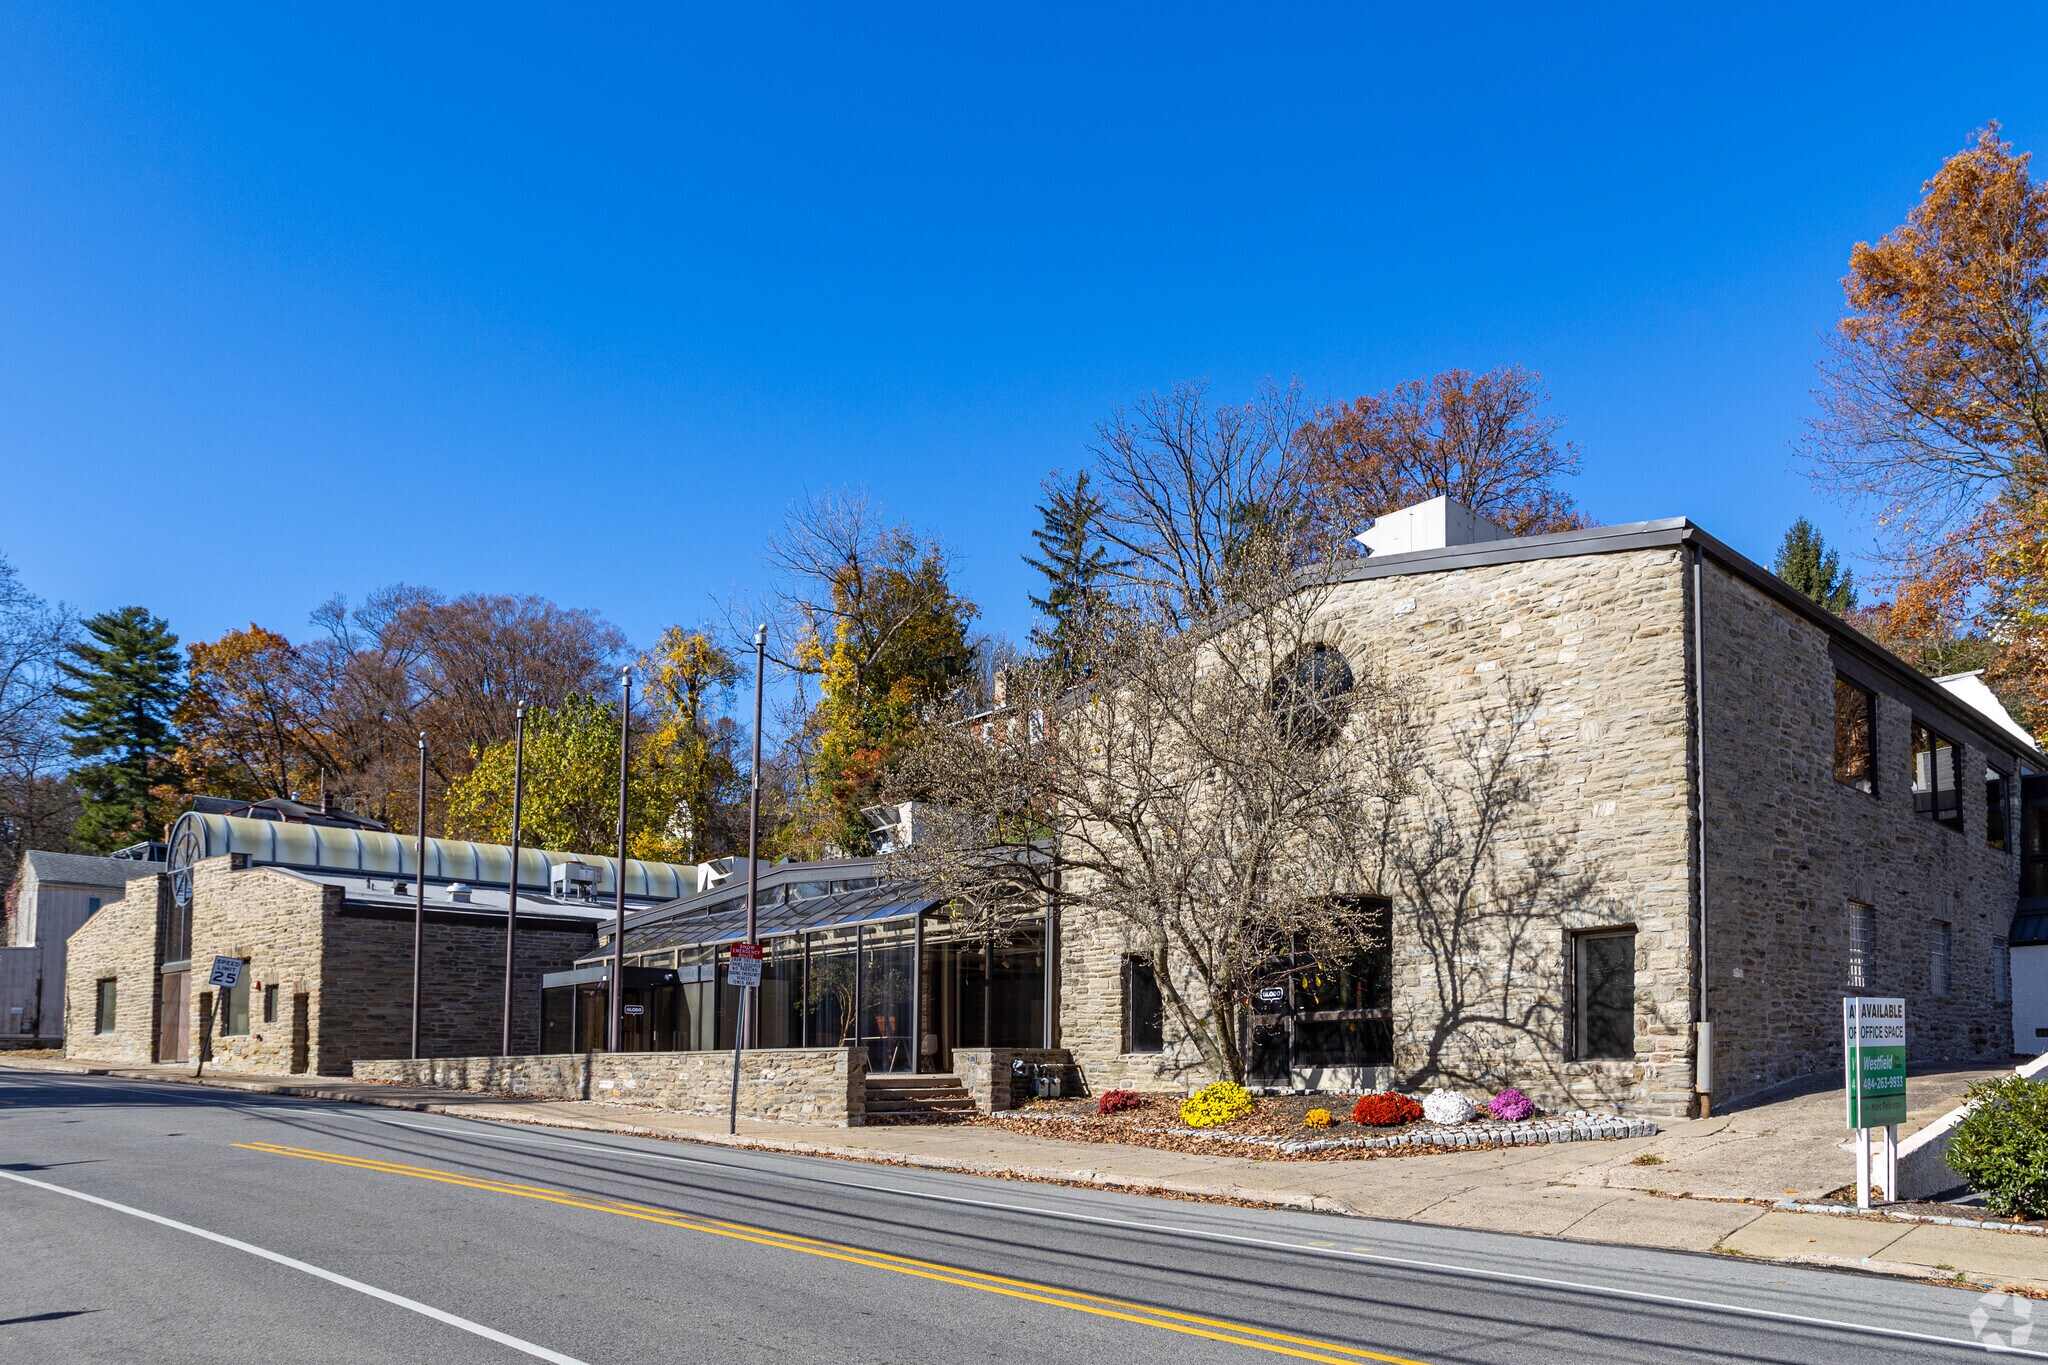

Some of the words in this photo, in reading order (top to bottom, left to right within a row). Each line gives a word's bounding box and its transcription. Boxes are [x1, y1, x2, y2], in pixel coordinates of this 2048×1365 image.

[216, 959, 240, 967] SPEED
[212, 971, 236, 984] 25
[1861, 1004, 1902, 1018] AVAILABLE
[1860, 1026, 1884, 1038] OFFICE
[1884, 1026, 1904, 1038] SPACE
[1864, 1055, 1893, 1070] Westfield
[1863, 1076, 1904, 1090] 484-263-9933
